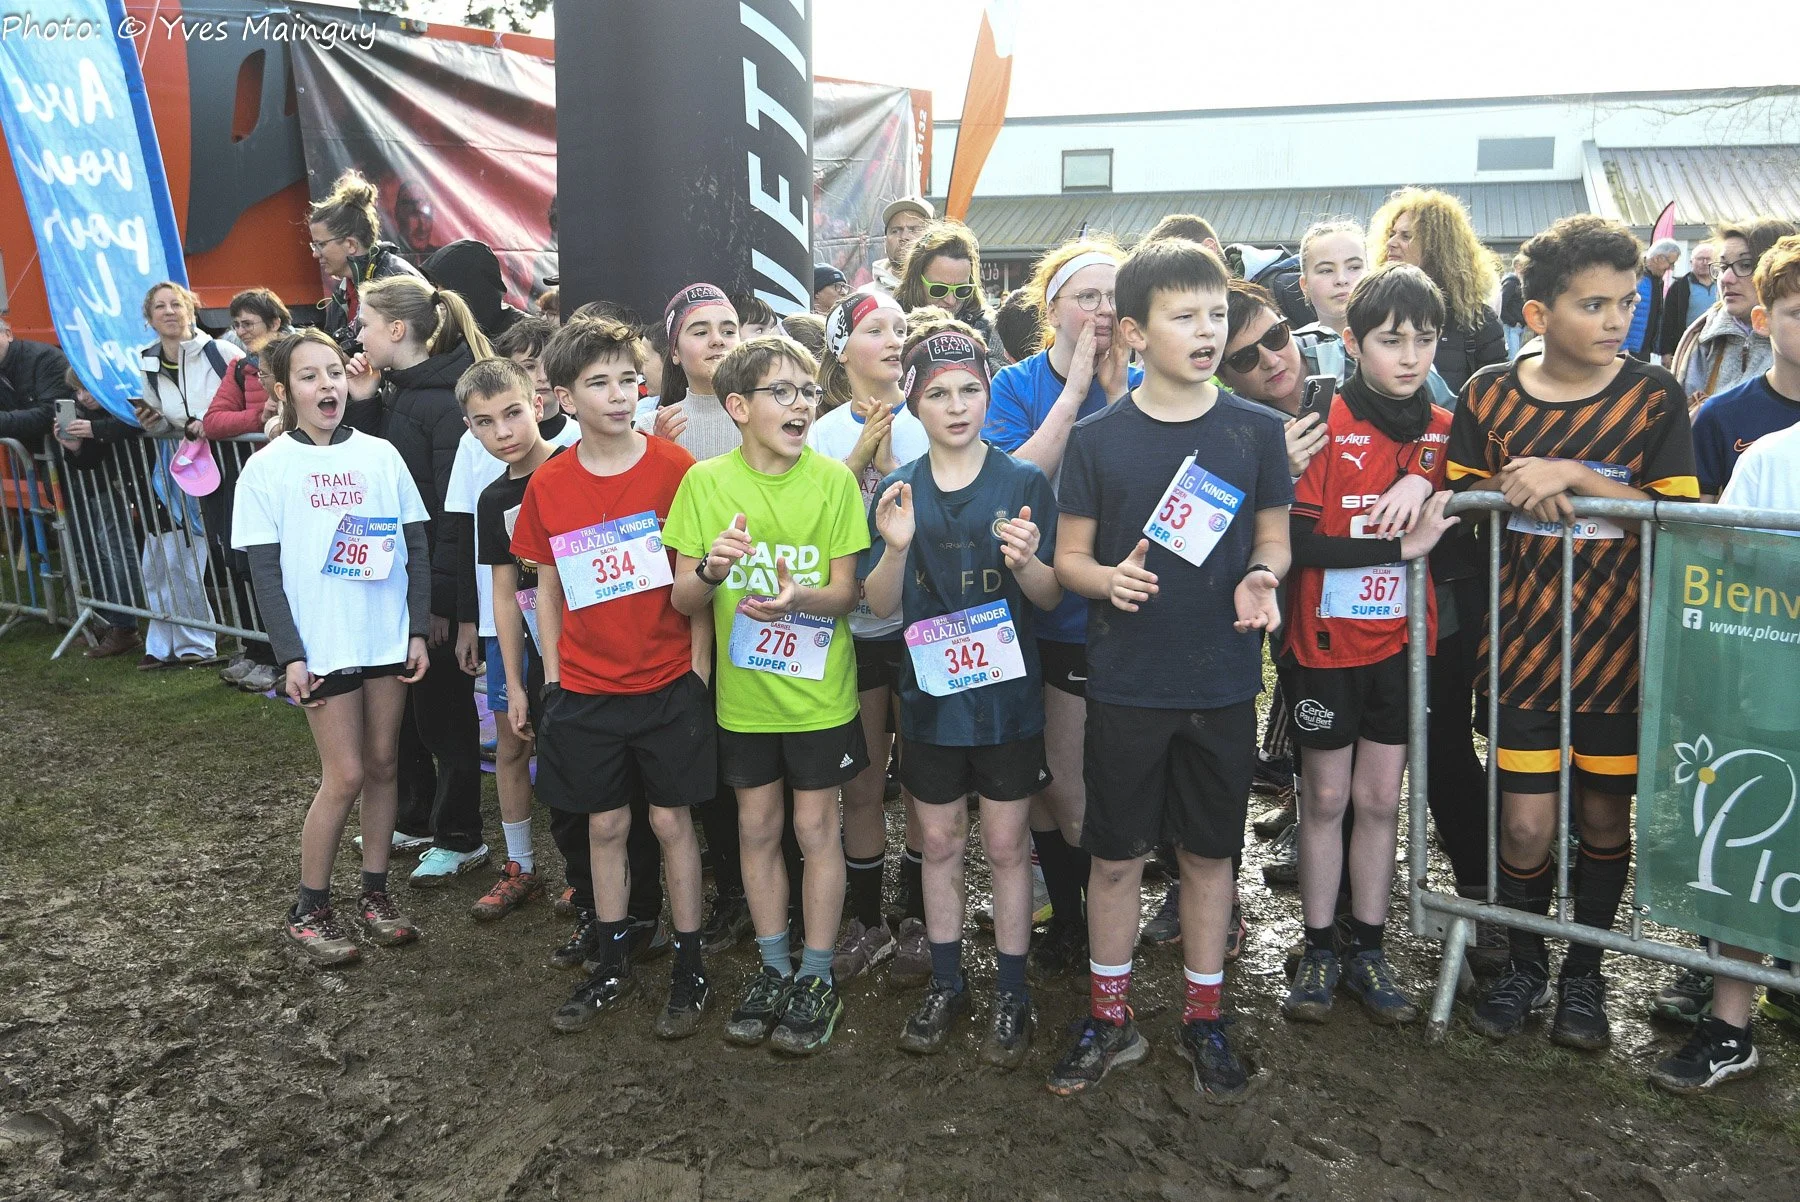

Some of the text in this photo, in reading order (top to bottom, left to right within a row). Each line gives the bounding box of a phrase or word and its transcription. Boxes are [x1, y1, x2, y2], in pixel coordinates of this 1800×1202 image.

[740, 0, 810, 330] VETI
[932, 336, 968, 347] TRAIL
[934, 343, 971, 355] GLAZIG
[1340, 433, 1371, 446] ARTE
[1414, 433, 1450, 444] AUNAY
[311, 473, 356, 487] TRAIL
[1594, 467, 1627, 479] NDER
[311, 492, 363, 508] GLAZIG
[1201, 481, 1239, 509] KINDER
[1160, 495, 1192, 530] 53
[369, 522, 397, 531] KINDER
[580, 527, 597, 537] TRAIL
[1535, 521, 1596, 535] SUPR U
[570, 518, 655, 554] GLAZIG KINDER
[1174, 539, 1183, 548] U
[333, 541, 368, 565] 296
[740, 541, 819, 571] ARD
[327, 564, 360, 577] SUPER
[592, 550, 635, 584] 334
[595, 581, 634, 599] SUPER
[1359, 575, 1400, 601] 367
[1683, 565, 1800, 619] Bienv
[1351, 605, 1400, 615] SUPER U
[923, 607, 1007, 643] GLAZIG KINDER
[932, 617, 950, 627] TRAIL
[756, 628, 797, 657] 276
[747, 656, 787, 671] SUPER
[944, 642, 989, 675] 342
[948, 670, 1000, 690] SUPER U
[1299, 711, 1315, 722] Paul
[1315, 717, 1333, 726] Bert
[1301, 703, 1335, 719] Cercle
